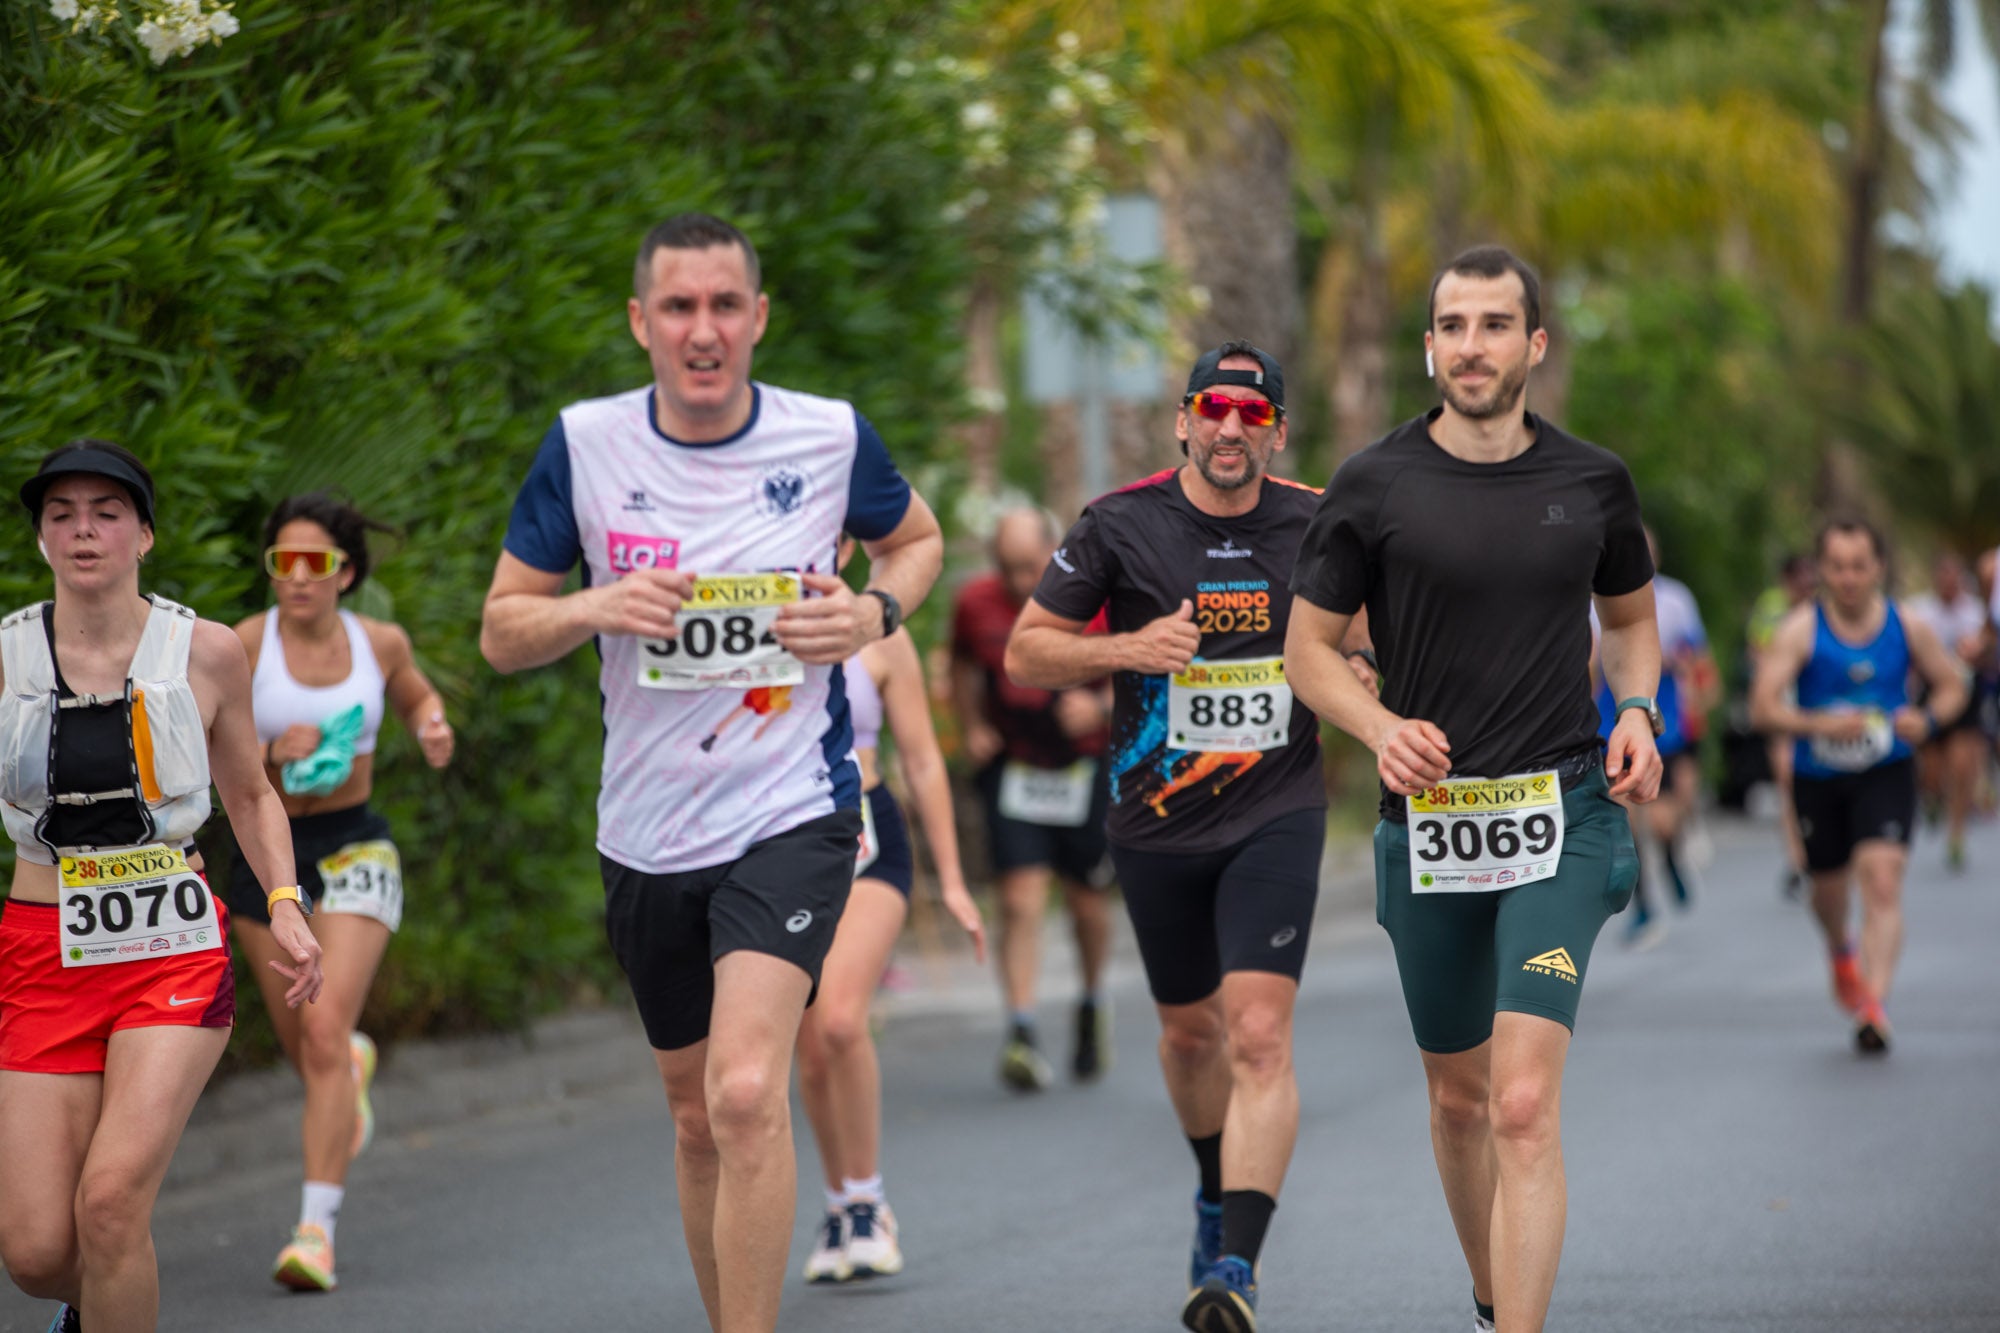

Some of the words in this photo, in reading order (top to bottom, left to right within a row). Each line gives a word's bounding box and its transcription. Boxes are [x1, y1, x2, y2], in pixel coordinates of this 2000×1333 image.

[698, 586, 767, 601] ONDO
[1196, 582, 1226, 592] GRAN
[1227, 579, 1269, 591] PREMIO
[1197, 591, 1270, 610] FONDO
[1198, 608, 1272, 633] 2025
[1207, 671, 1269, 684] FONDO
[1190, 693, 1274, 728] 883
[1482, 782, 1518, 790] PREMIO
[1427, 787, 1449, 805] 38
[1450, 788, 1526, 806] FONDO
[1416, 813, 1557, 862] 3069
[100, 855, 128, 865] GRAN
[130, 849, 165, 860] PREMIO
[78, 860, 98, 879] 38
[98, 855, 174, 879] FONDO
[66, 879, 207, 937] 3070
[1522, 964, 1551, 975] NIKE
